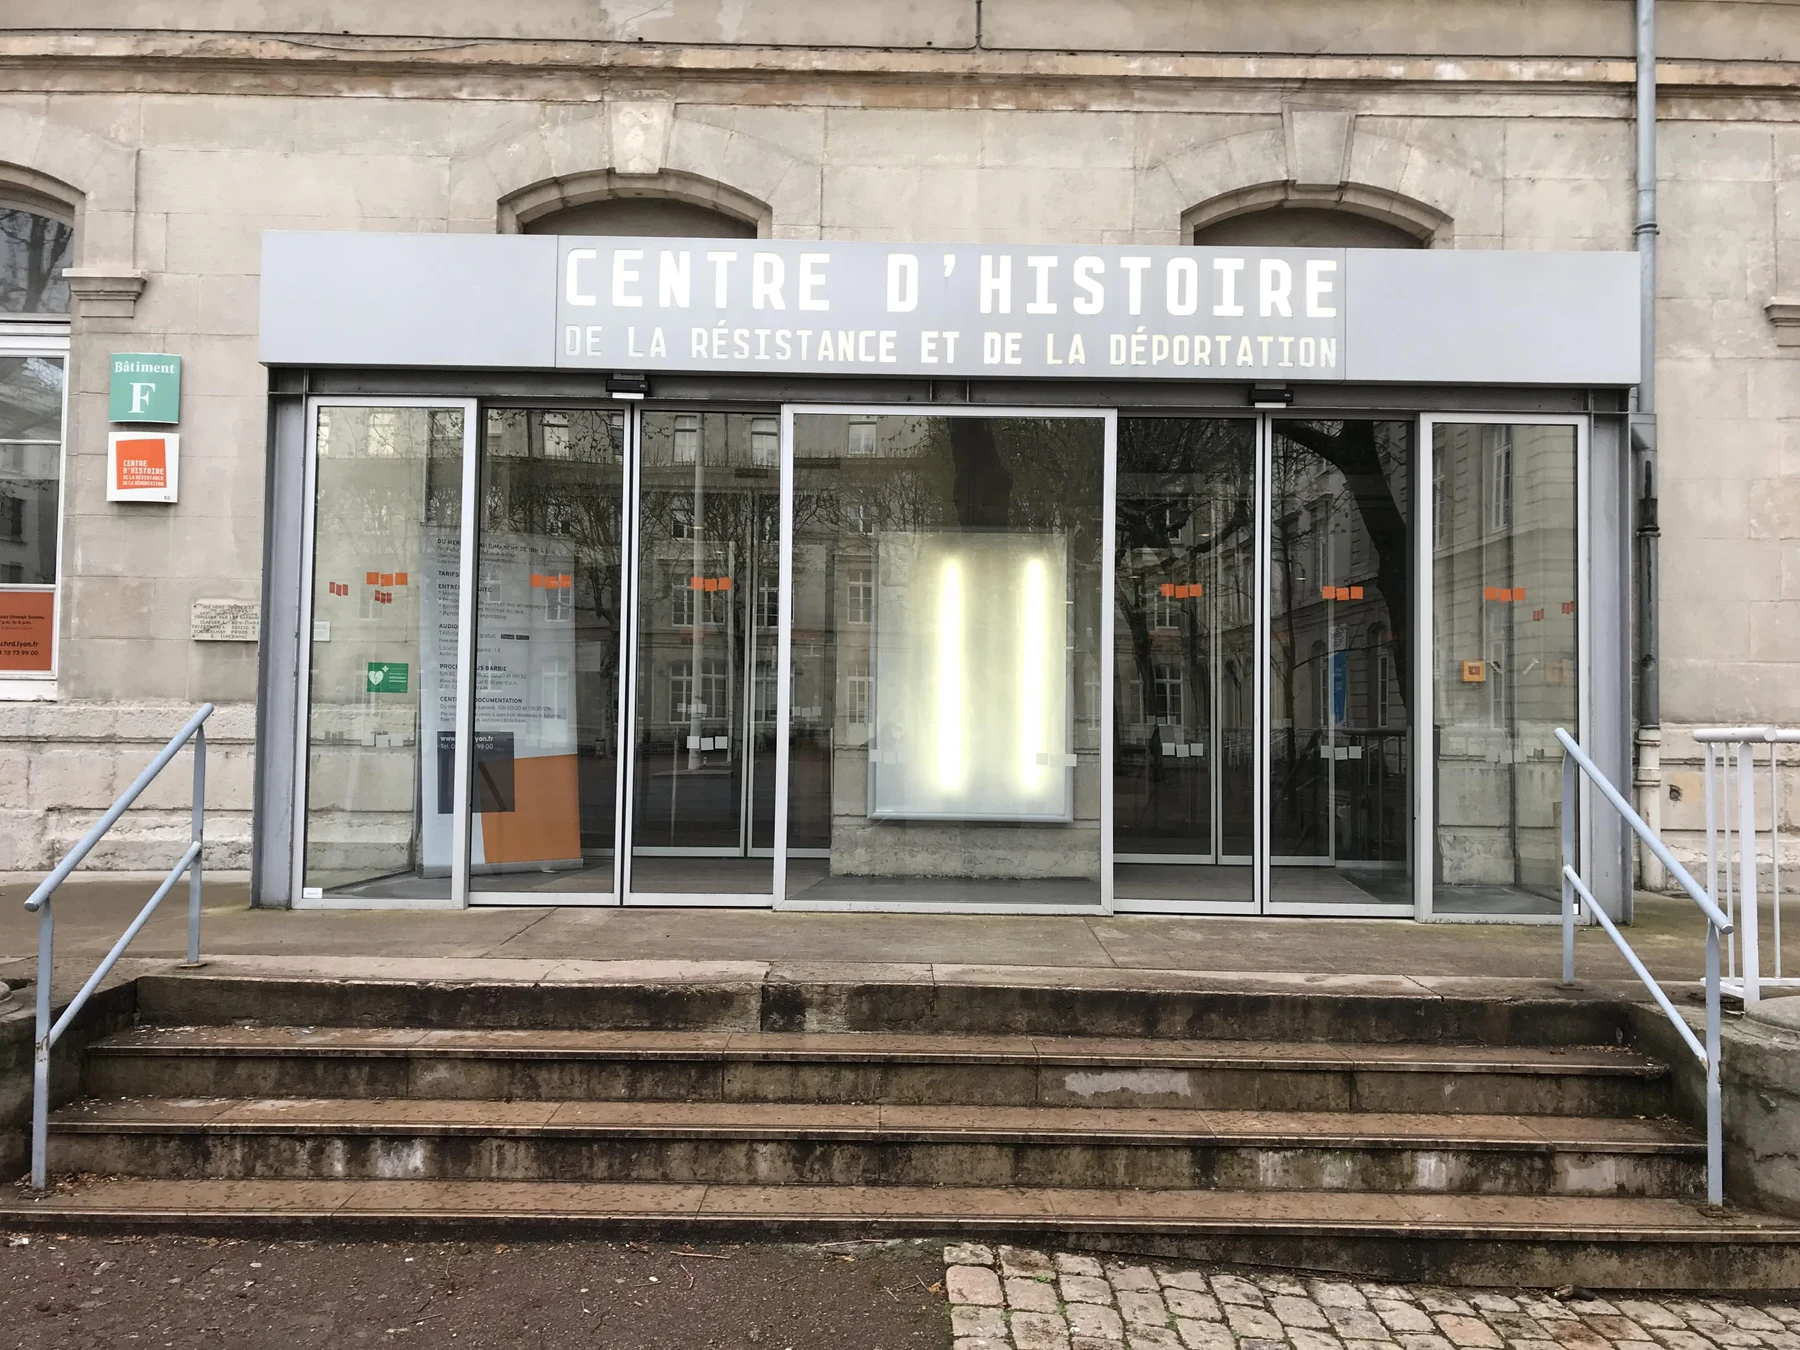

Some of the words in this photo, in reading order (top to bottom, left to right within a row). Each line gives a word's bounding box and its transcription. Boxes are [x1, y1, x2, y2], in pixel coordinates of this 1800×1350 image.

[565, 248, 830, 311] CENTRE
[886, 253, 1337, 318] D'HISTOIRE
[565, 325, 602, 357] DE
[628, 326, 667, 358] LA
[690, 320, 897, 363] RÉSISTANCE
[921, 331, 960, 364] ET
[983, 332, 1022, 365] DE
[1046, 333, 1086, 366] LA
[1109, 326, 1337, 368] DÉPORTATION
[114, 360, 175, 374] Bâtiment
[128, 382, 156, 414] F
[123, 467, 164, 475] D'HISTOIRE
